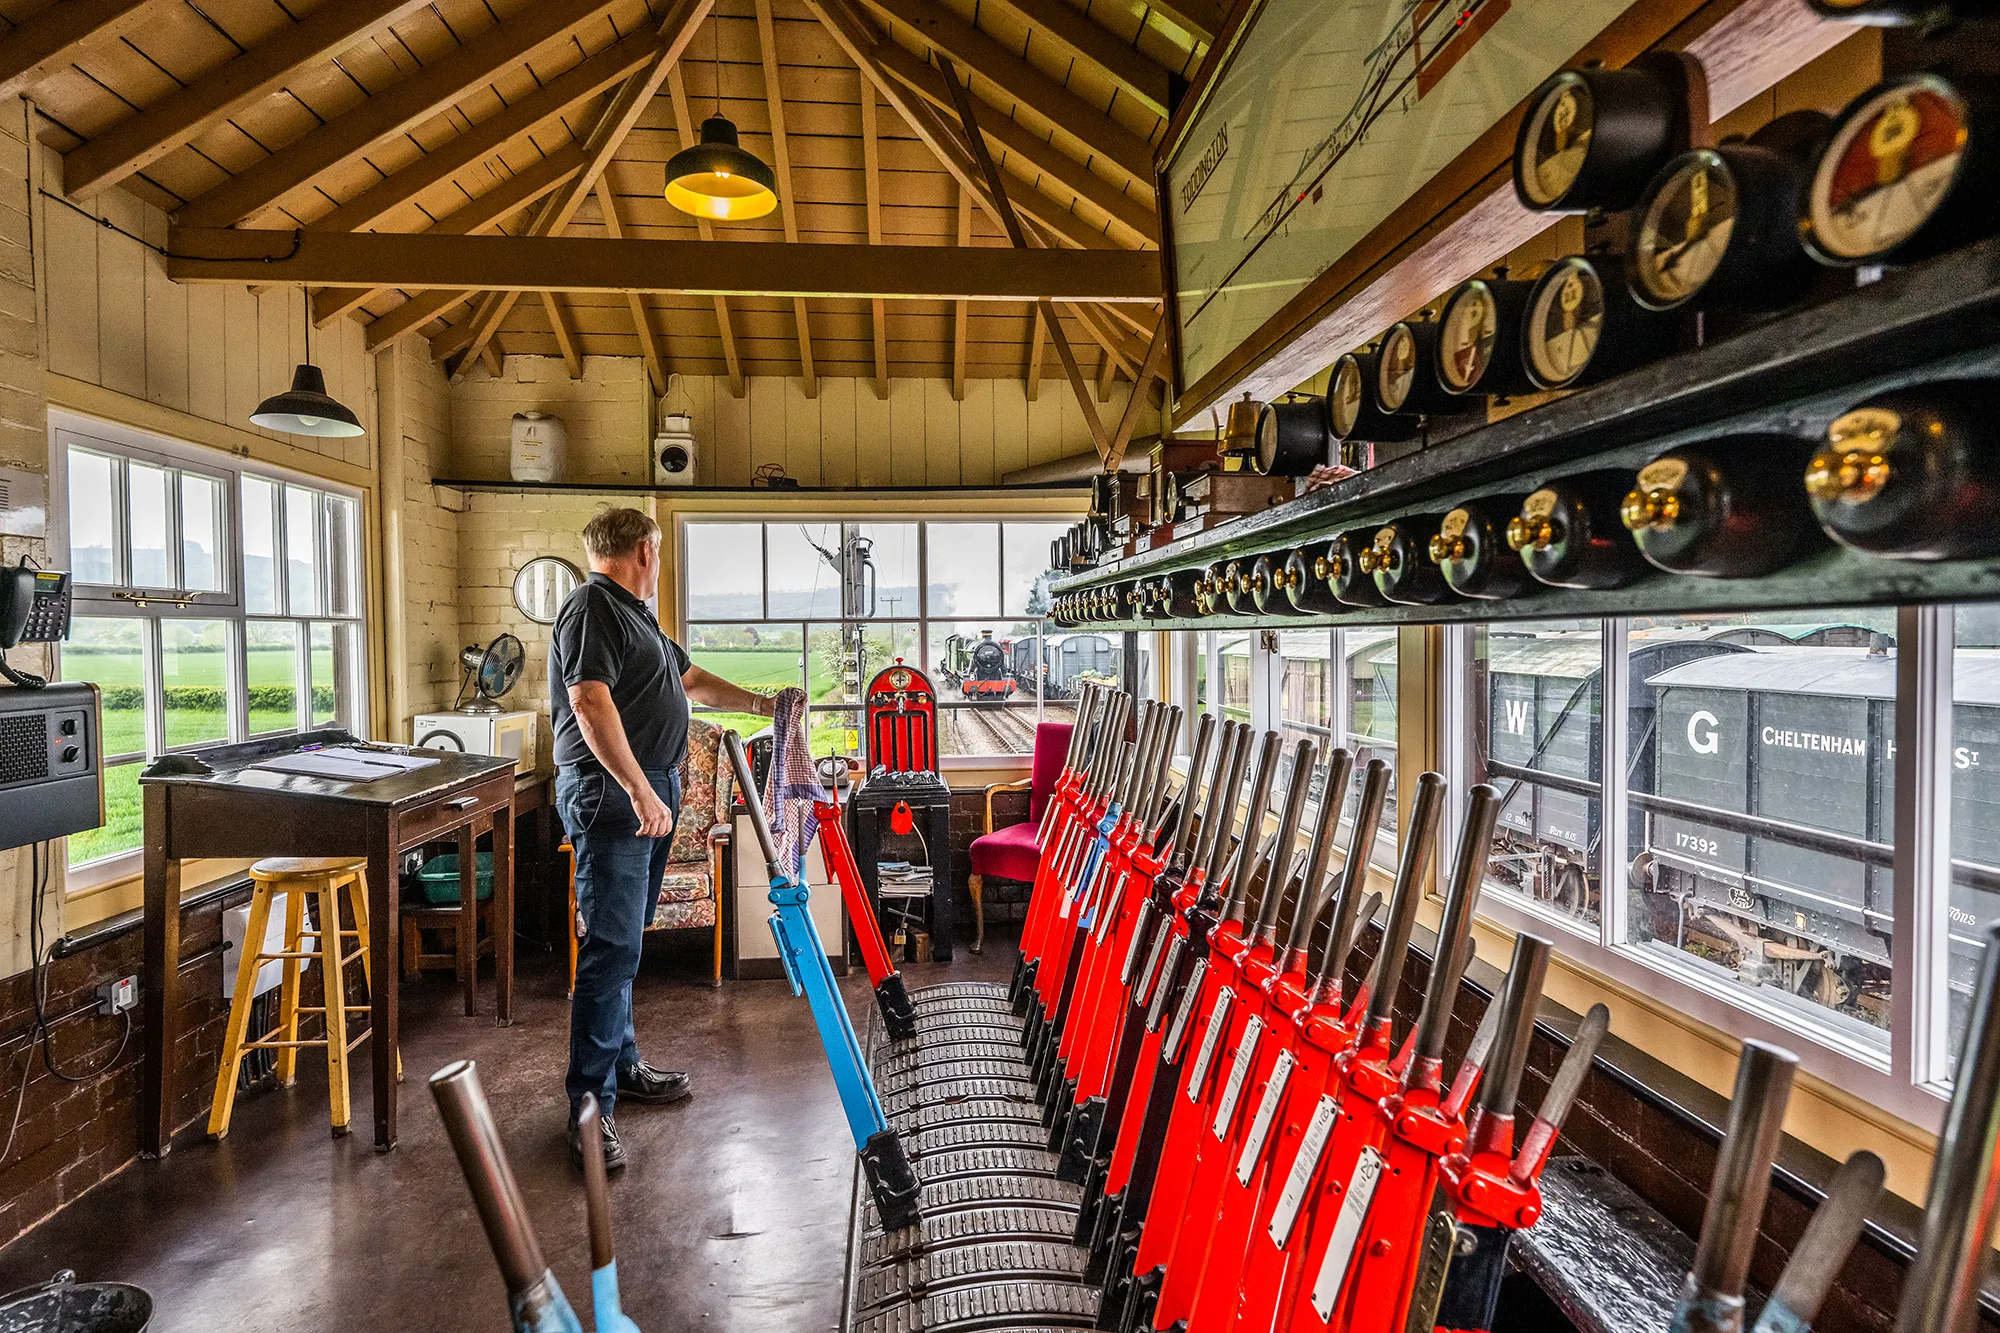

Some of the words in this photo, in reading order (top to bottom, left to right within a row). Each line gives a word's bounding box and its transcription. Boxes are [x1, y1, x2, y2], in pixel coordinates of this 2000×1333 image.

[1181, 121, 1228, 208] TODDINGTON
[1505, 699, 1529, 736] W
[1687, 710, 1719, 755] G
[1761, 726, 1866, 757] CHELTENHAM
[1676, 832, 1718, 857] 17392
[1359, 1157, 1375, 1181] 20
